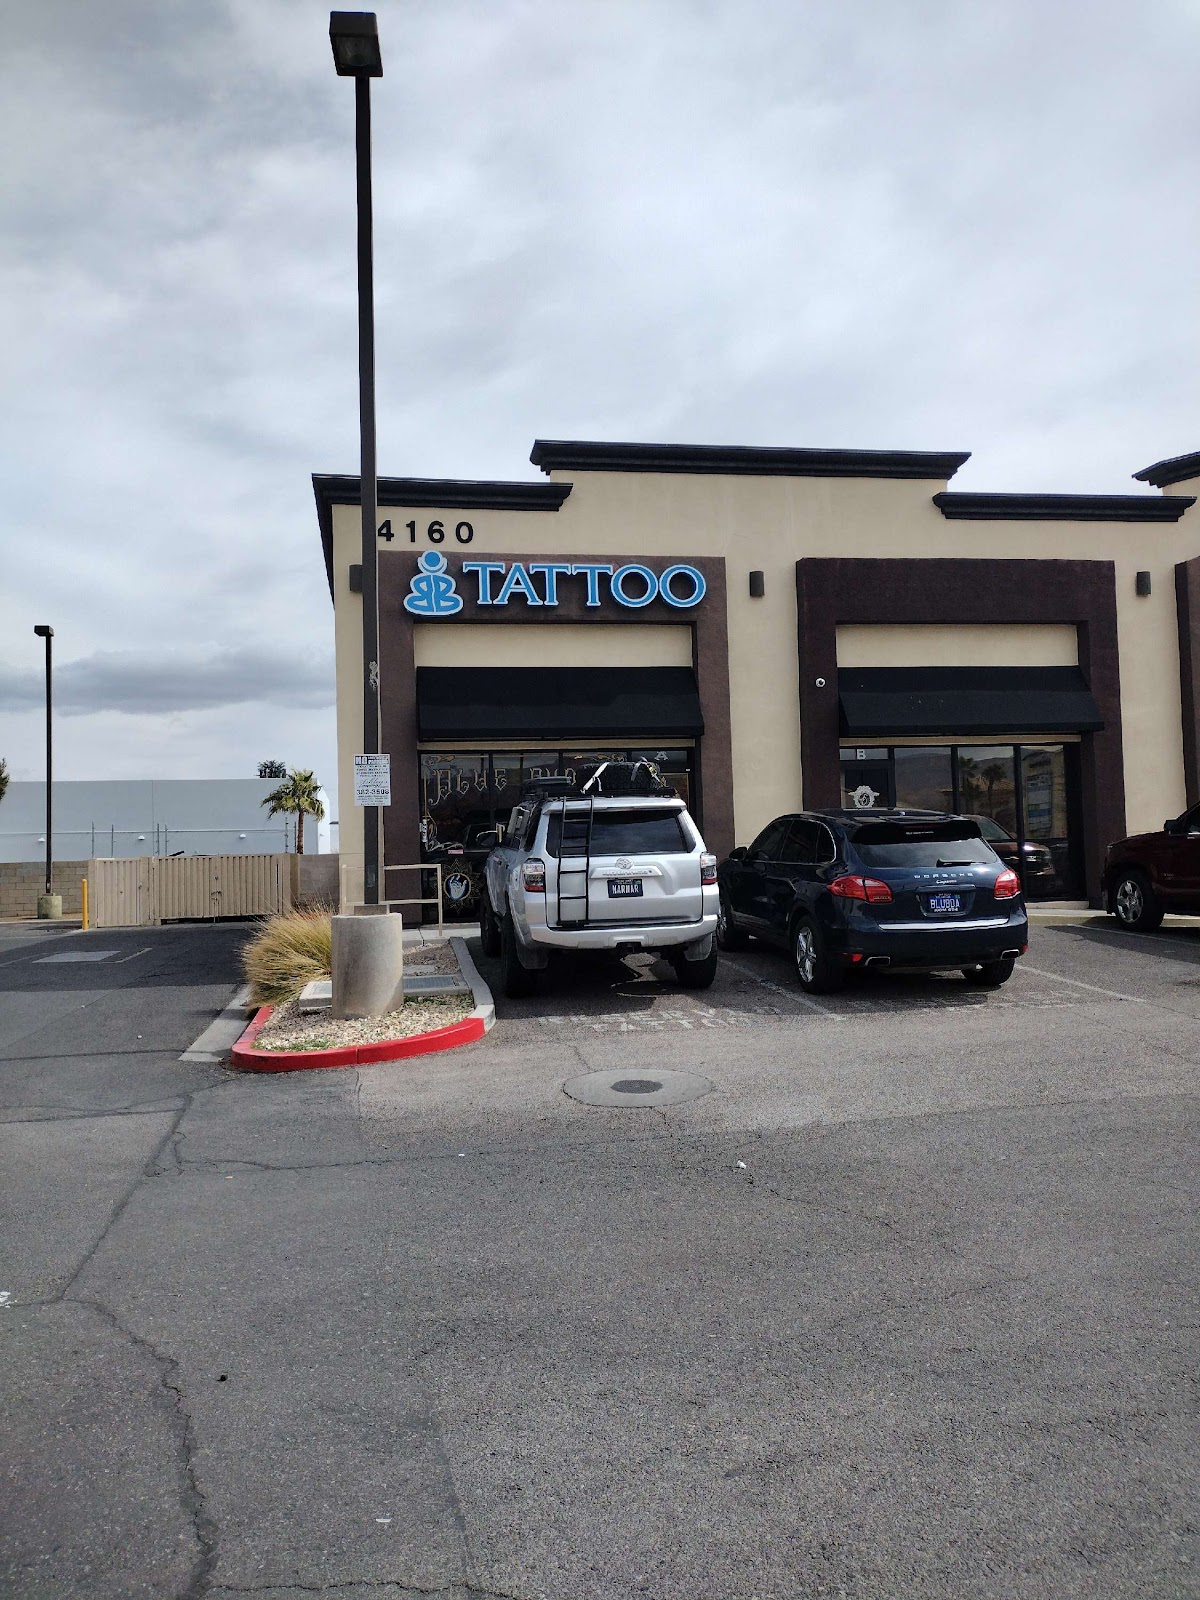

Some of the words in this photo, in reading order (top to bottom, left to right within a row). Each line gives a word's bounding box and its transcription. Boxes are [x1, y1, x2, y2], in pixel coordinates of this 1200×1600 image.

[377, 519, 474, 544] 4160
[462, 561, 707, 608] TATTOO
[856, 748, 867, 760] B
